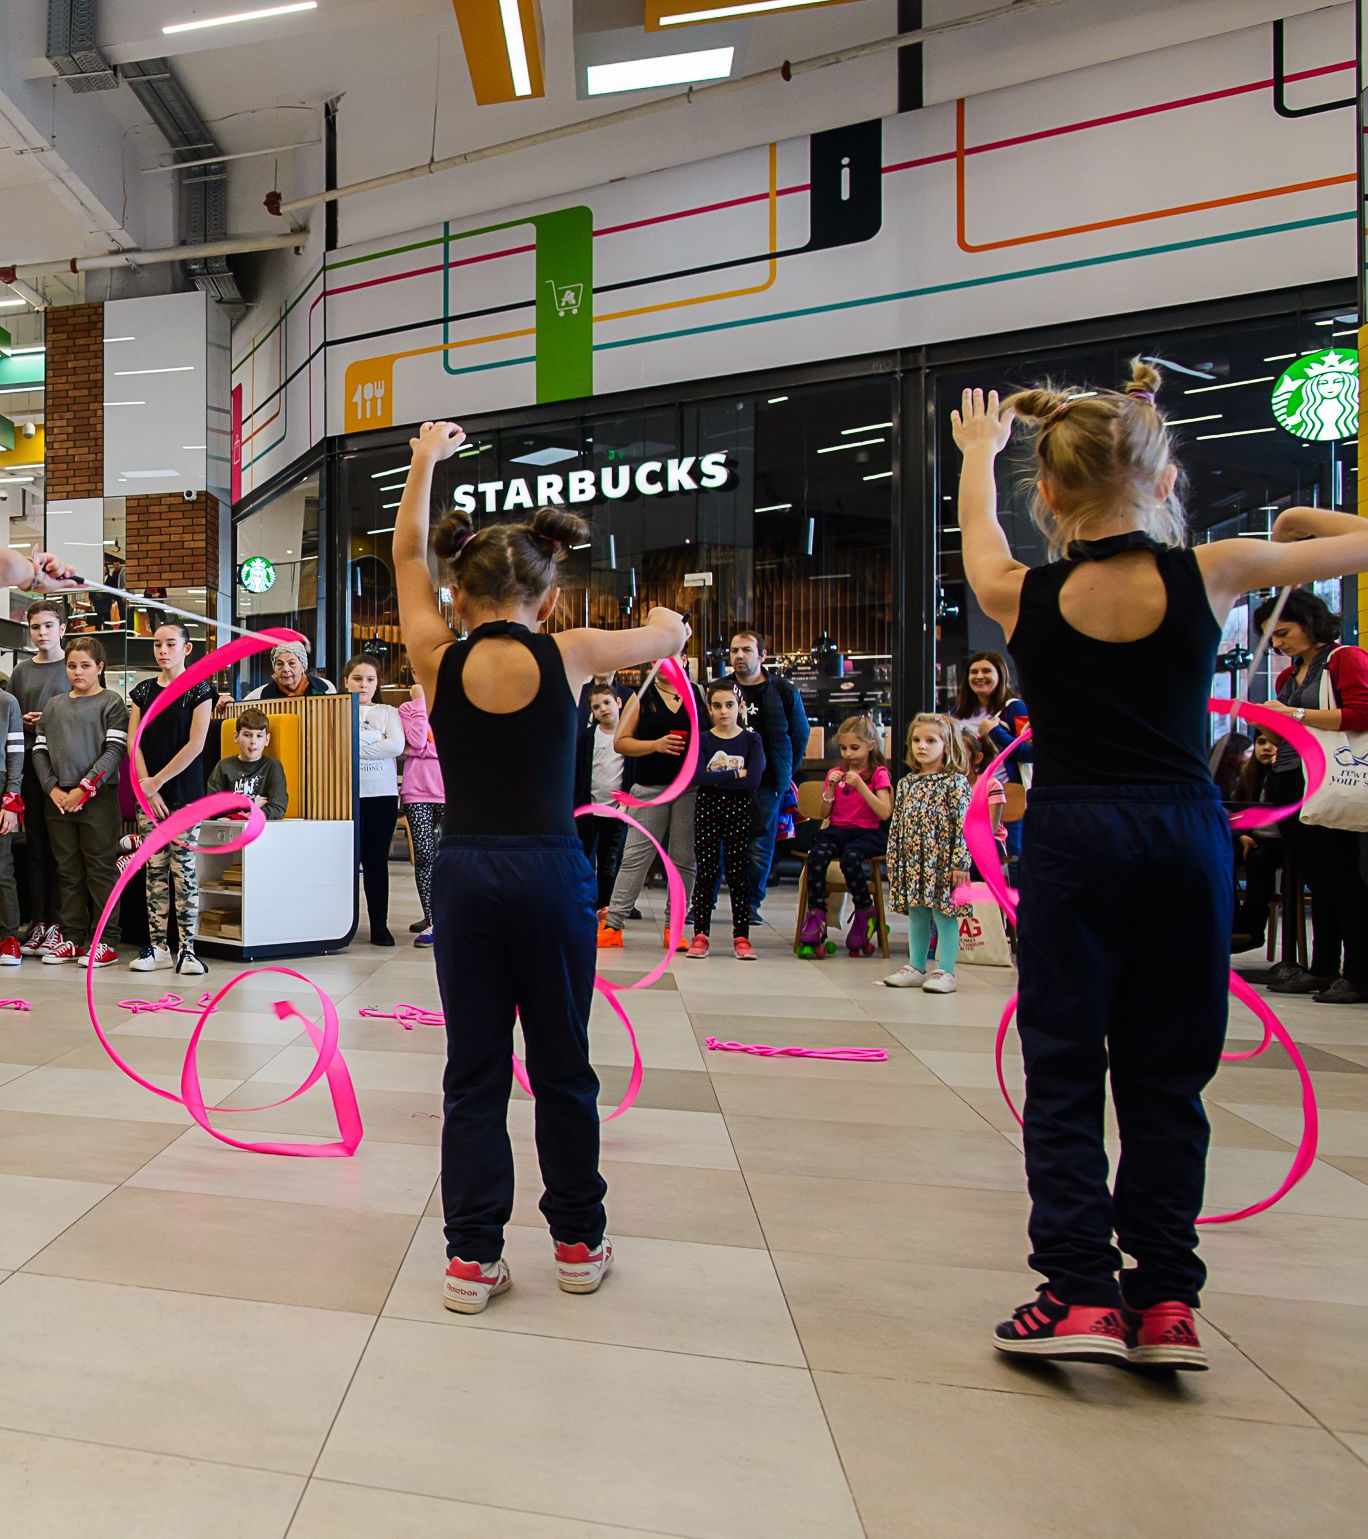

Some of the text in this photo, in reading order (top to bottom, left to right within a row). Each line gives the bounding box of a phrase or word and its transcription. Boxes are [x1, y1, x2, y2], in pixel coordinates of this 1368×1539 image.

[453, 453, 729, 515] STARBUCKS
[558, 1268, 590, 1278] Reebok
[446, 1282, 478, 1297] Reebok
